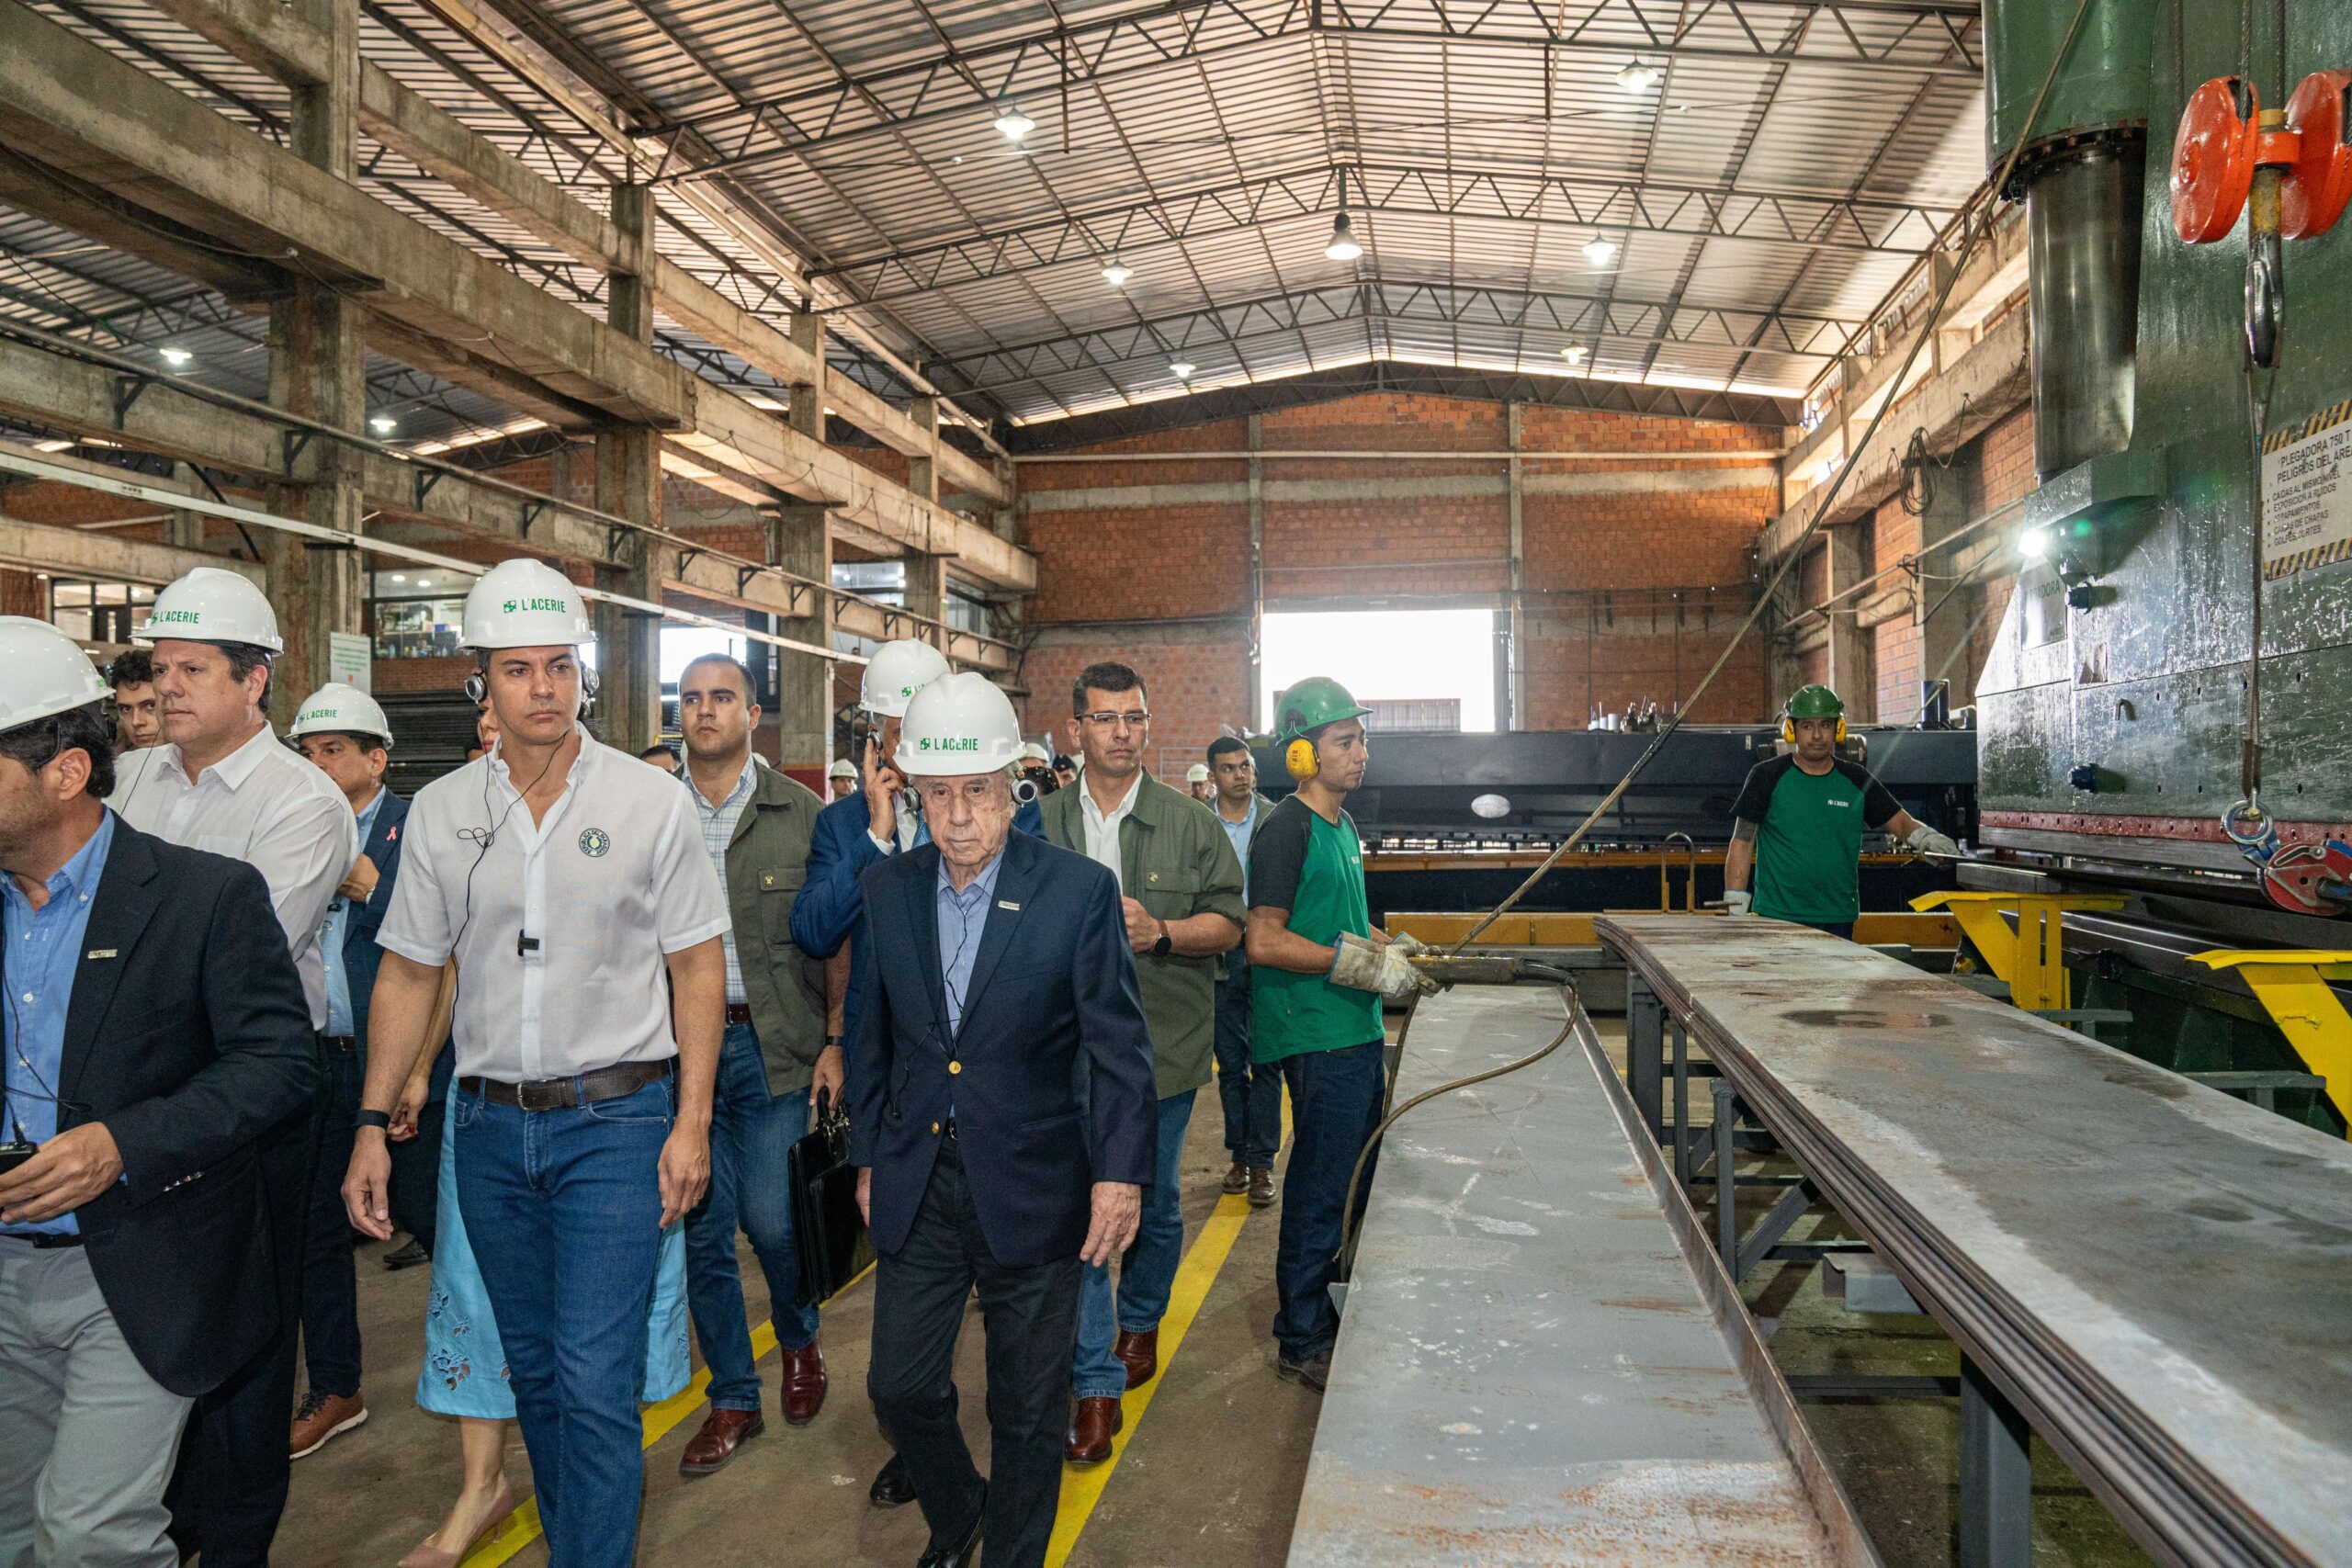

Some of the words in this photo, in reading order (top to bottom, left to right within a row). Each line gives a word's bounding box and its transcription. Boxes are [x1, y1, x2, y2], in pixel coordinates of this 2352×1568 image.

[2280, 439, 2328, 467] PLEGADORA
[2330, 433, 2343, 446] 750
[2345, 430, 2350, 441] T
[2278, 460, 2314, 483] PELIGROS
[2316, 454, 2332, 469] DEL
[2334, 446, 2352, 462] ARE
[2272, 487, 2293, 502] CAIDAS
[2293, 483, 2301, 493] AL
[2302, 476, 2322, 490] MISMO
[2274, 494, 2307, 512] EXPOSICION
[2308, 490, 2313, 499] A
[2313, 482, 2337, 498] RUIDOS
[2295, 518, 2303, 528] DE
[2304, 509, 2329, 525] CHAPAS
[522, 598, 566, 613] L'ACERIE
[160, 611, 200, 624] L'ACERIE
[307, 709, 338, 720] L'ACERIE
[934, 738, 978, 750] LACERIE
